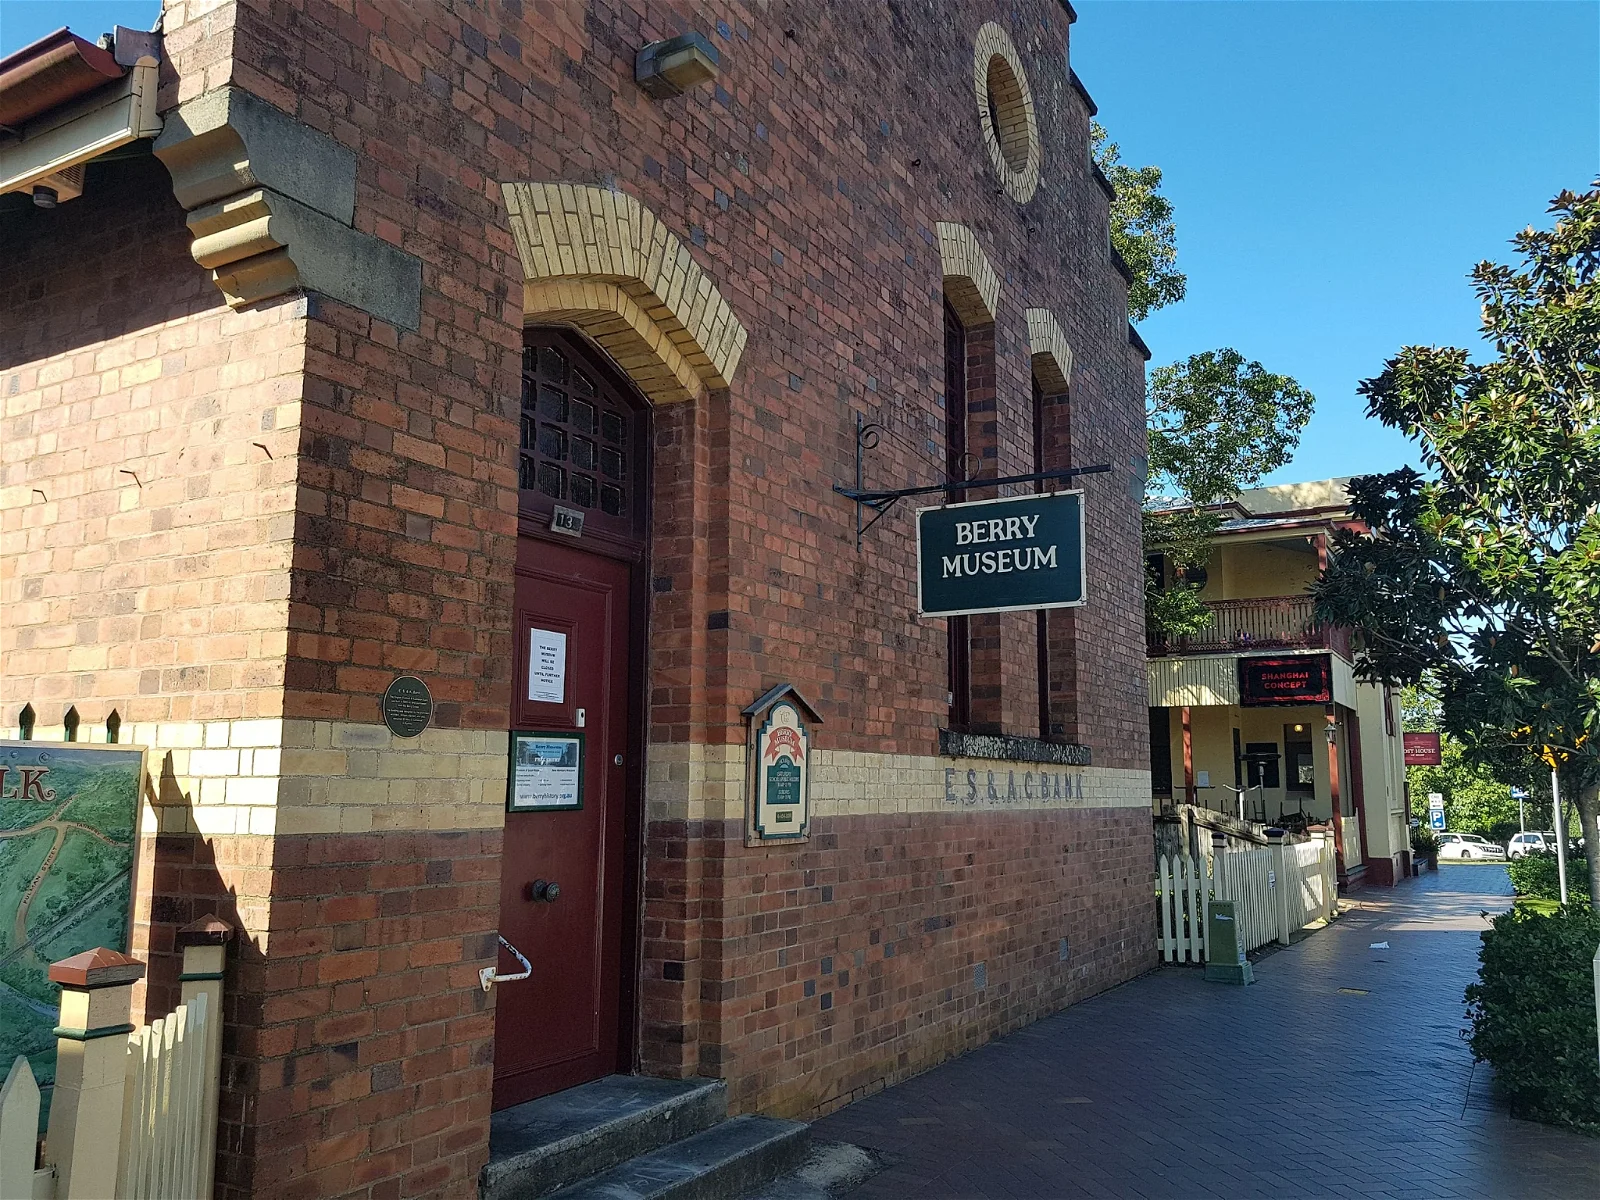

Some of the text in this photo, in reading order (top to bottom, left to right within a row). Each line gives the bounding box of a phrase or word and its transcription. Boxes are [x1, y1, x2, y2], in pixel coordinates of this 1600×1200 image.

[560, 514, 573, 528] 13
[956, 515, 1040, 545] BERRY
[942, 545, 1058, 578] MUSEUM
[1261, 672, 1309, 680] SHANGHAI
[1264, 681, 1307, 689] CONCEPT
[774, 735, 796, 746] MUSEUM
[1432, 812, 1441, 821] P
